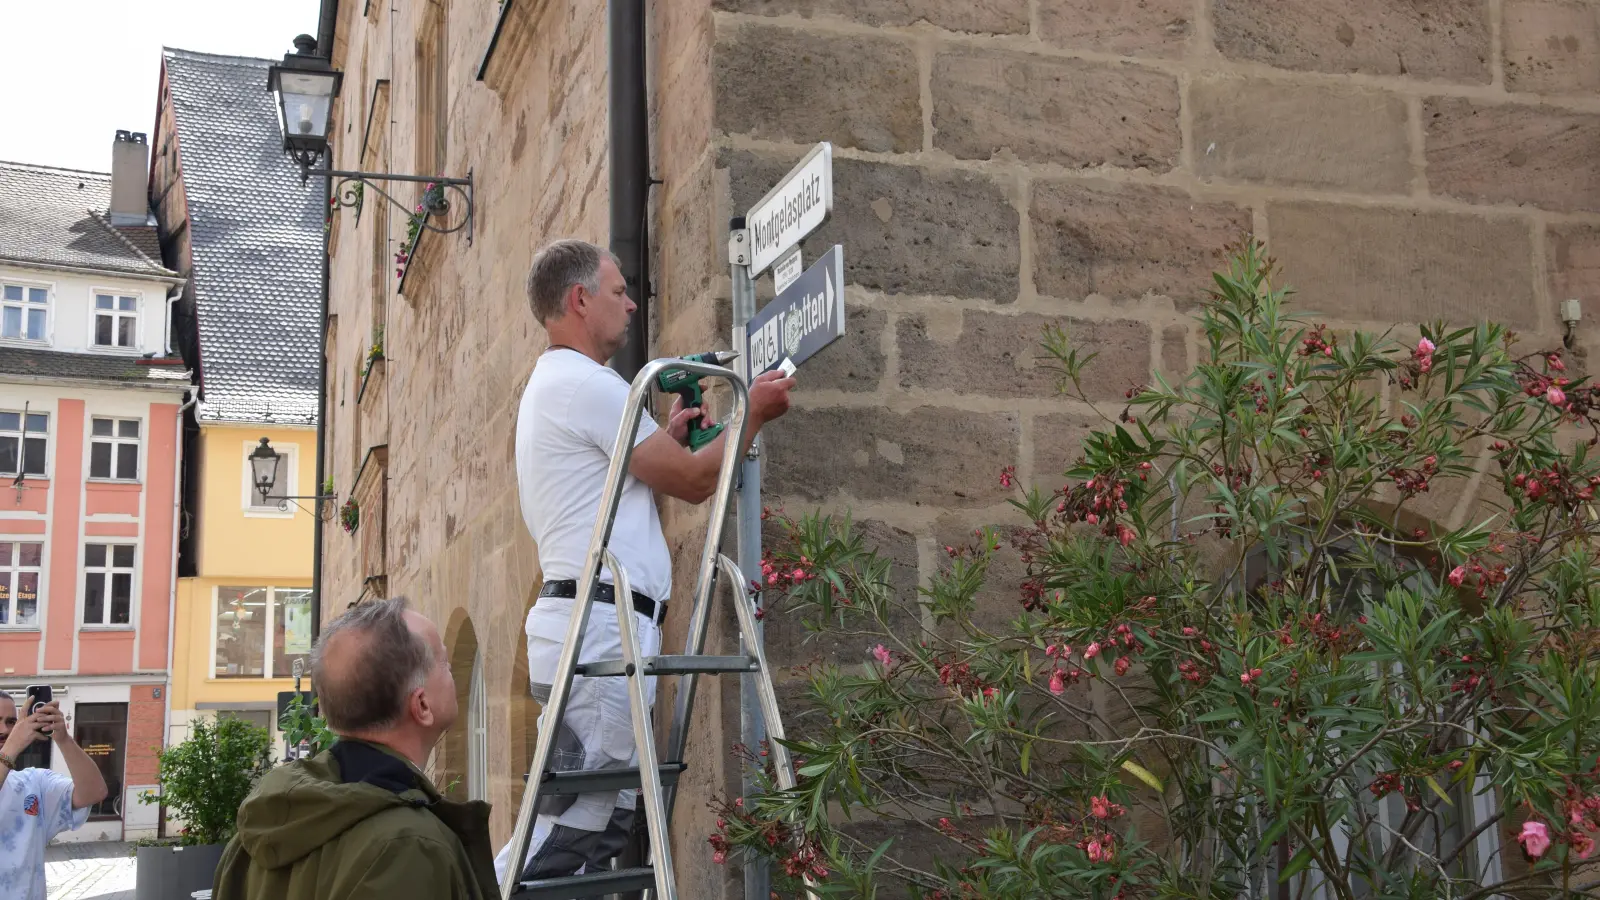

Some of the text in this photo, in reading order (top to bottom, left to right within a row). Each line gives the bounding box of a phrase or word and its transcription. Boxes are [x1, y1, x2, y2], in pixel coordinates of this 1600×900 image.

[754, 172, 821, 256] Montgelasplatz
[752, 291, 825, 369] WC Tetten
